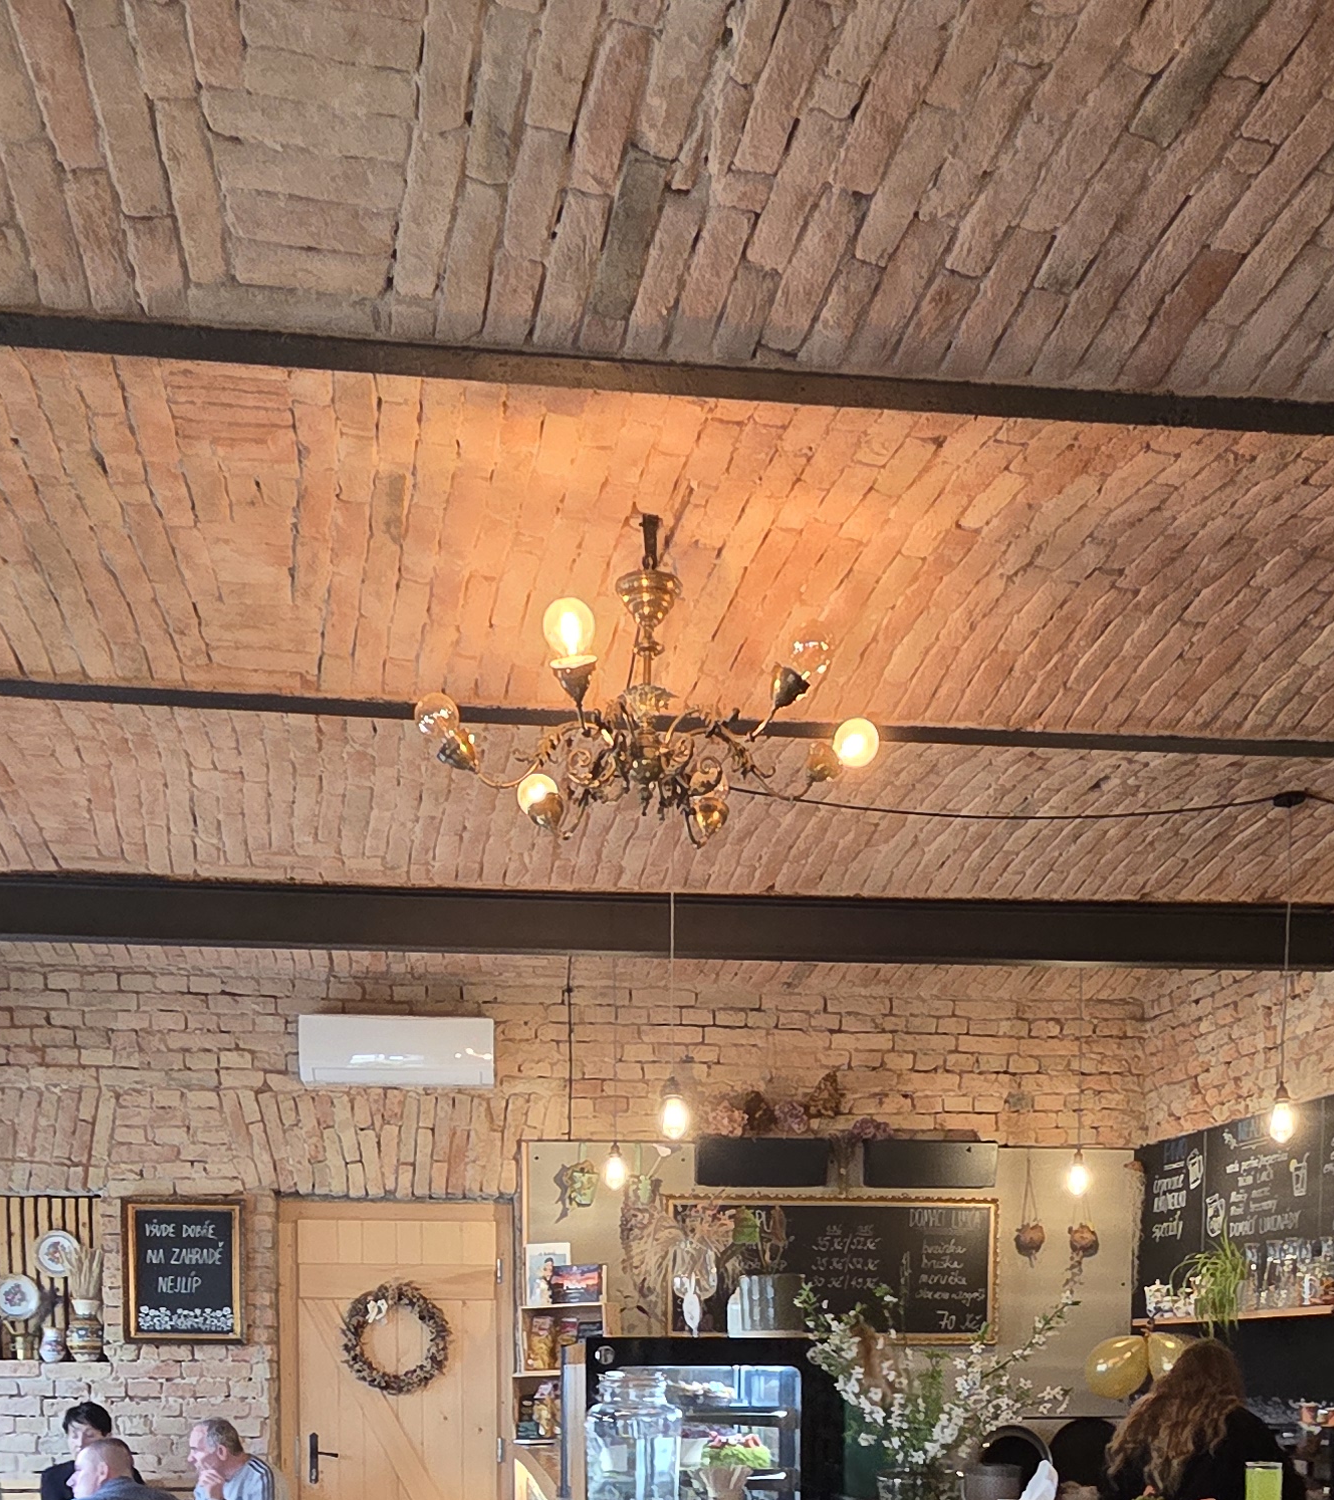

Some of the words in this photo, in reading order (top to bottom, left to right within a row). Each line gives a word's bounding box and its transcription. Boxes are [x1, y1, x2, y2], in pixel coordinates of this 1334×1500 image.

[145, 1218, 176, 1237] VŠUDE
[146, 1248, 165, 1264] NA
[170, 1241, 225, 1265] ZAHRADĚ
[157, 1270, 202, 1293] NEJLÍP
[936, 1310, 956, 1331] 70
